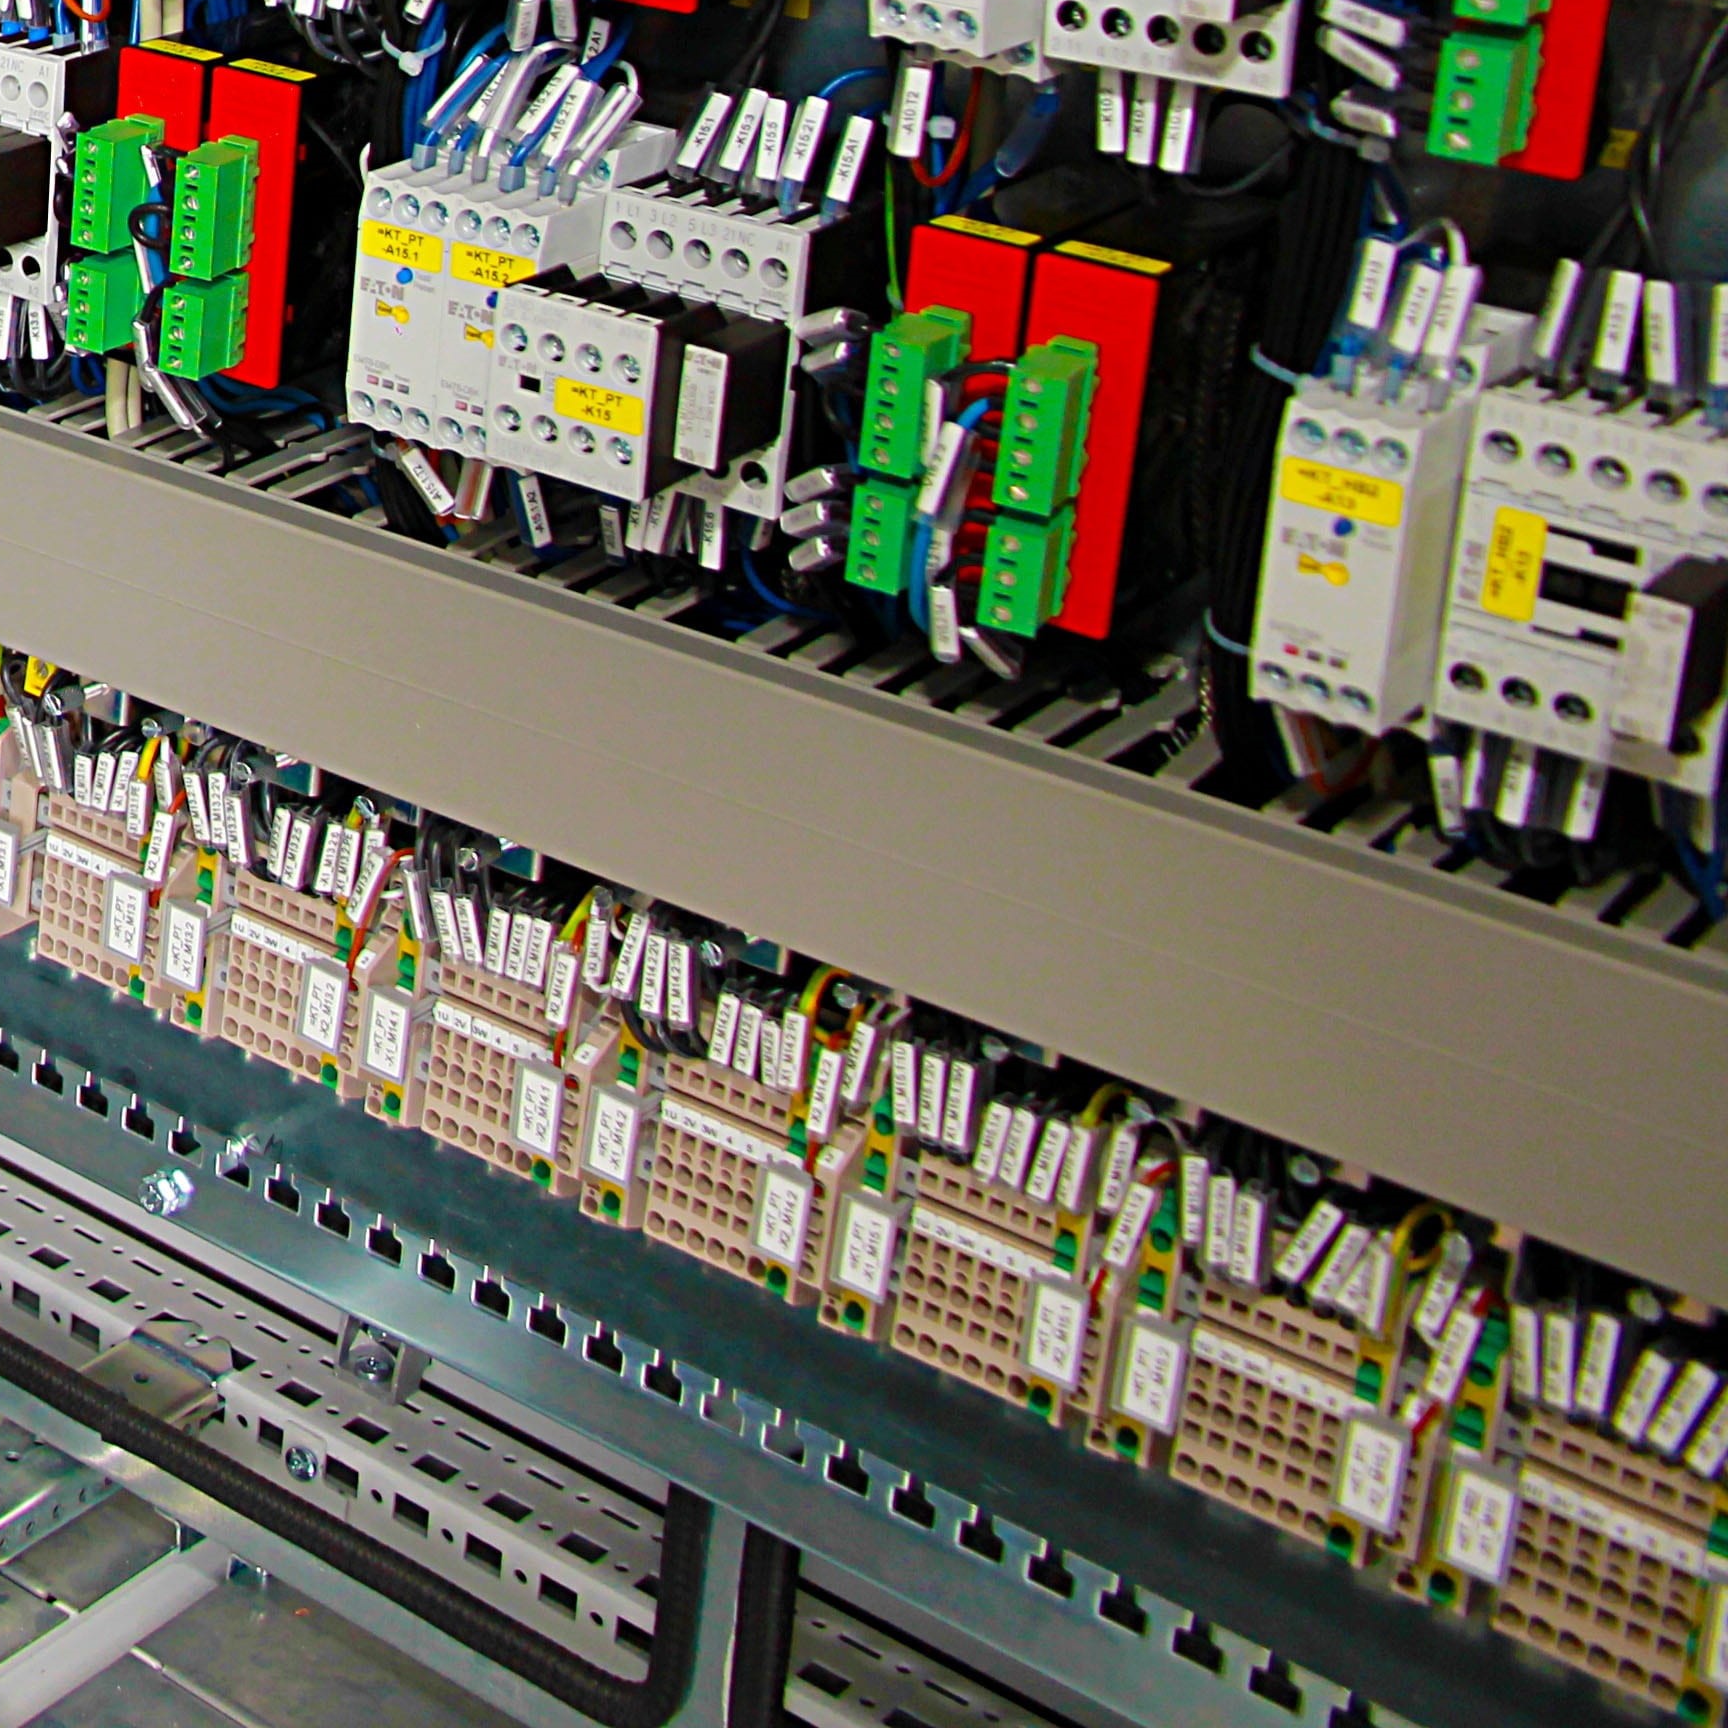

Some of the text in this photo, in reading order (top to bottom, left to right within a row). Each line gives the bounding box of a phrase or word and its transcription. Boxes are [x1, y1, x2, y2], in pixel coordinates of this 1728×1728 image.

[377, 228, 424, 248] =KT_PT
[381, 245, 419, 262] -A15.1
[466, 249, 515, 272] =KT_PT
[469, 265, 510, 284] -A15.2
[570, 384, 623, 408] =KT_PT
[580, 403, 612, 422] -K15
